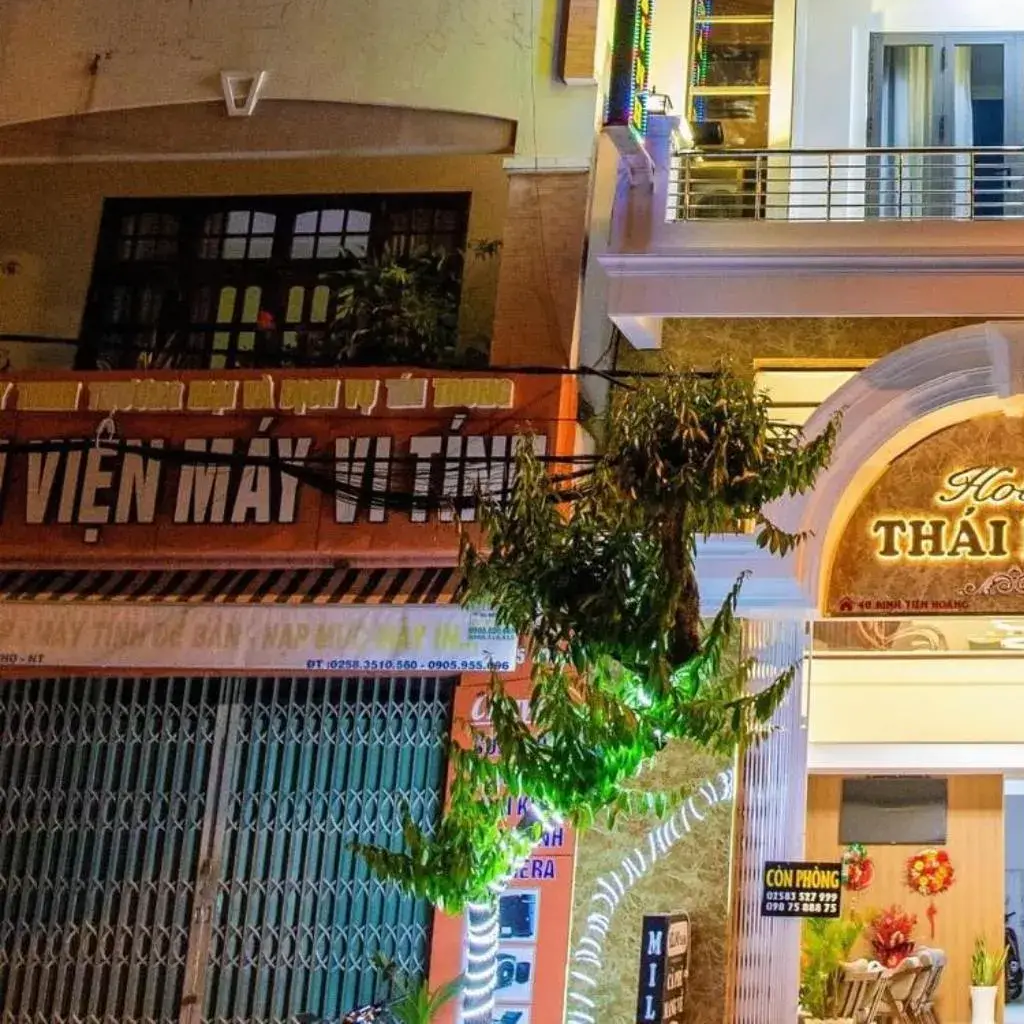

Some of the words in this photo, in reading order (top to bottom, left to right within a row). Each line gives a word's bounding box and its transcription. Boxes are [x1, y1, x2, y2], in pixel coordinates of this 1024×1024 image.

[27, 417, 164, 543] VIỆN
[175, 417, 311, 523] MÁY
[335, 437, 391, 522] VI
[873, 506, 1008, 558] THÁI
[765, 864, 793, 888] CÒN
[795, 865, 840, 889] PHÒNG
[787, 902, 800, 912] 75
[823, 903, 837, 913] 75
